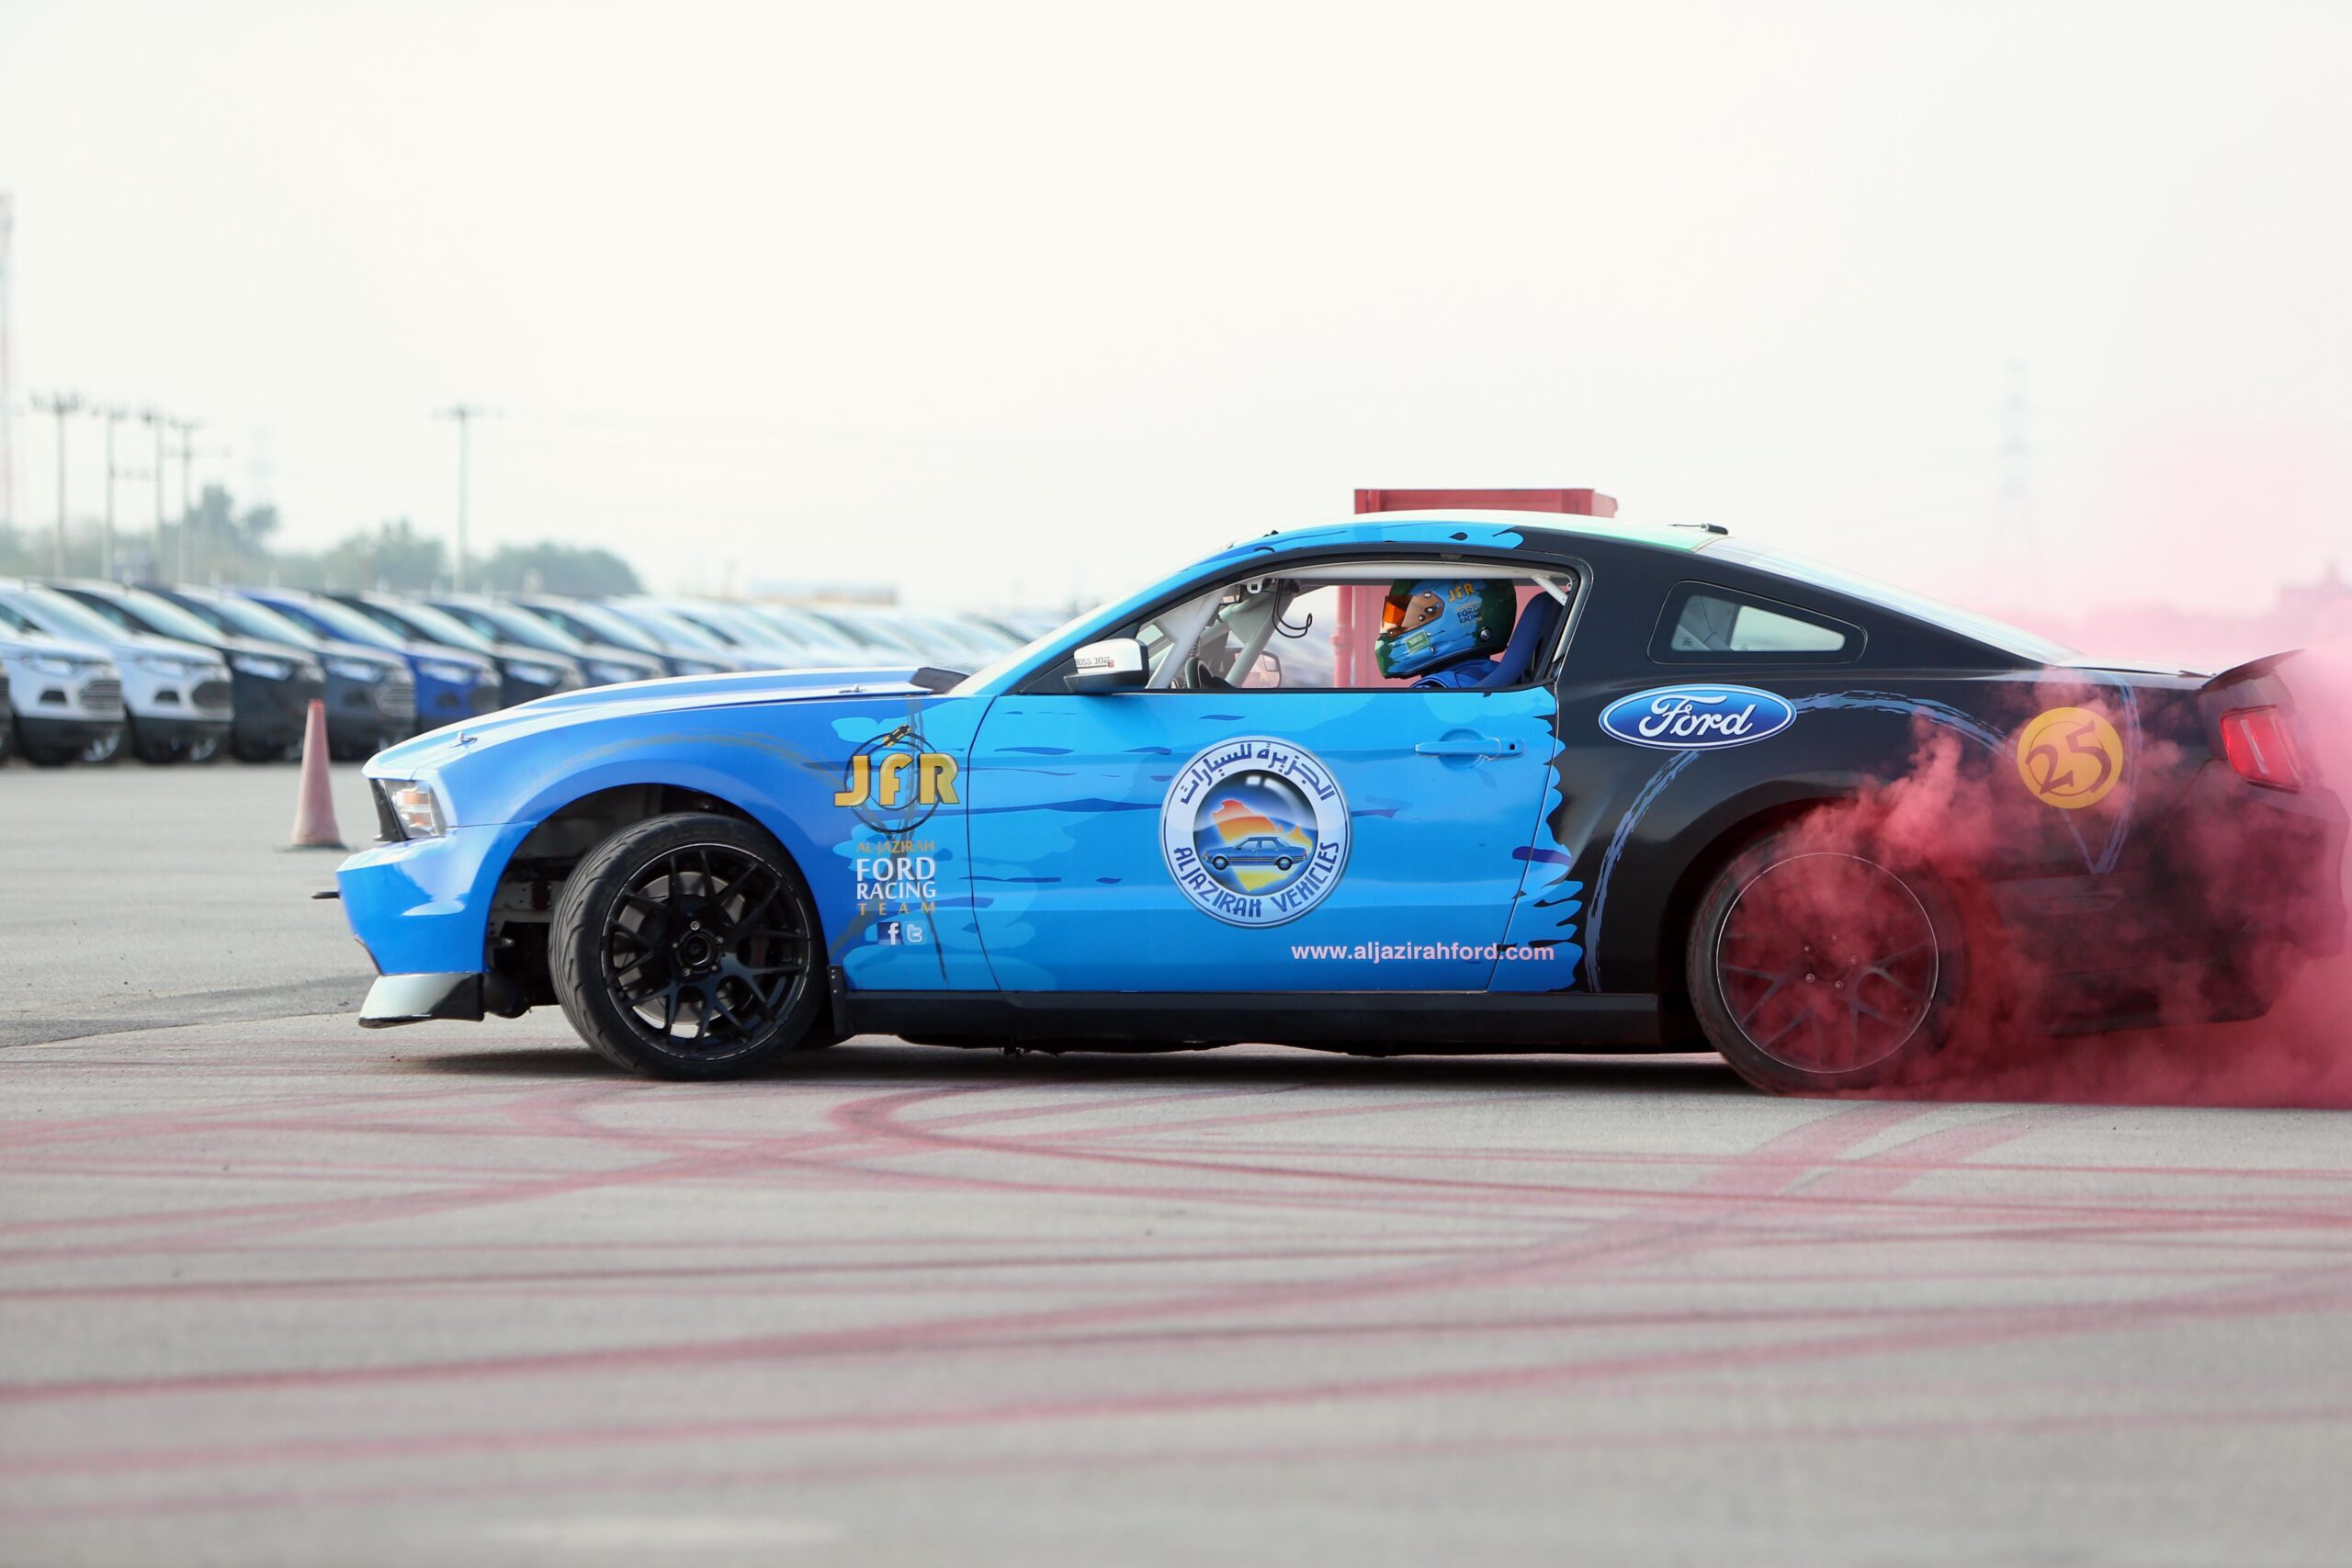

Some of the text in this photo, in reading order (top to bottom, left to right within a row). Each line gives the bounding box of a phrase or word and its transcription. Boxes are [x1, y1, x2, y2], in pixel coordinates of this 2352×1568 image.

[1638, 694, 1757, 738] Ford
[1180, 742, 1336, 805] الجزيرة للسيارات
[2025, 719, 2112, 795] 25
[856, 856, 936, 882] FORD
[1270, 841, 1340, 913] VEHICLES
[856, 881, 937, 900] RACING
[857, 901, 936, 916] TEAM
[1291, 942, 1555, 964] www.aljazirahford.com
